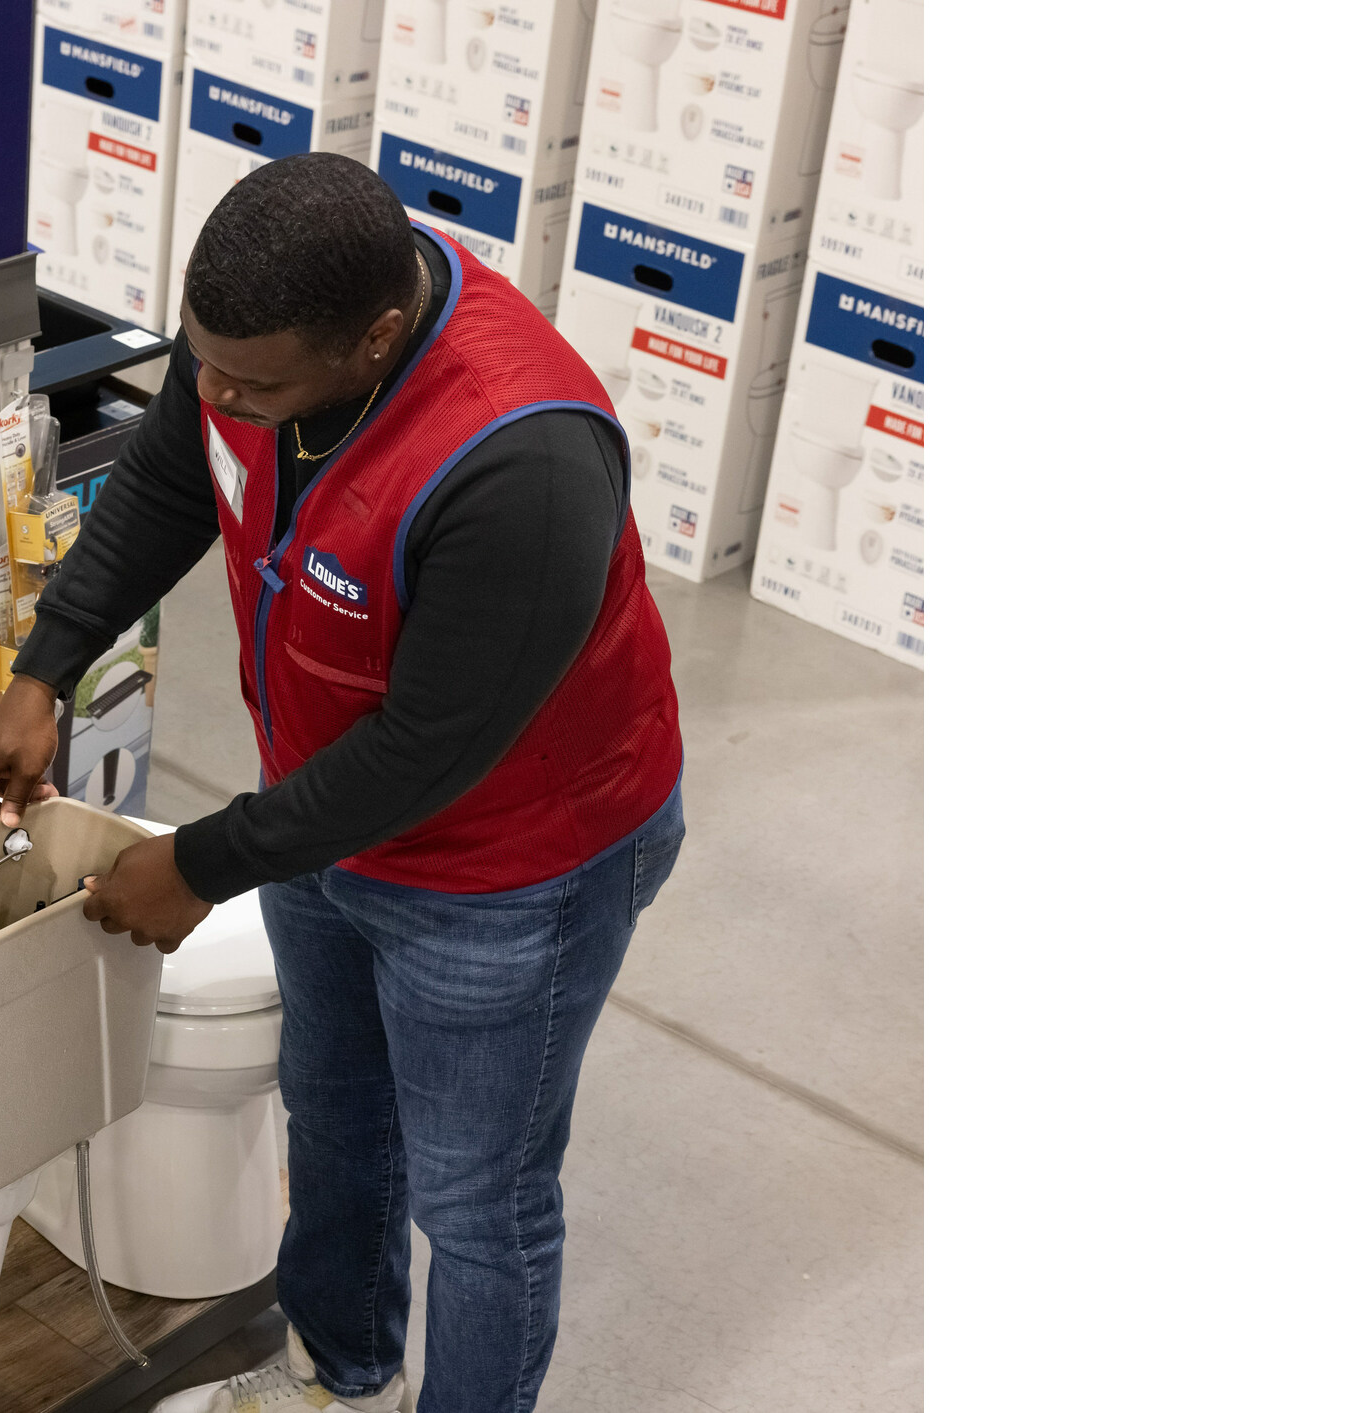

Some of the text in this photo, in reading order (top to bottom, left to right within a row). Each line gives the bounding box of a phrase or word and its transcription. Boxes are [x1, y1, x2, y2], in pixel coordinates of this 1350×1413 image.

[71, 45, 143, 78] MANSFIELD
[221, 89, 292, 126] MANSFIELD
[414, 154, 496, 195] MANSFIELD
[619, 227, 714, 270] MANSFIELD
[713, 325, 723, 344] 2
[855, 299, 924, 338] MANSFI
[892, 381, 924, 411] VANQ
[45, 500, 76, 519] UNIVERSAL
[307, 552, 360, 600] LOWE'S
[300, 578, 369, 620] Customer Service
